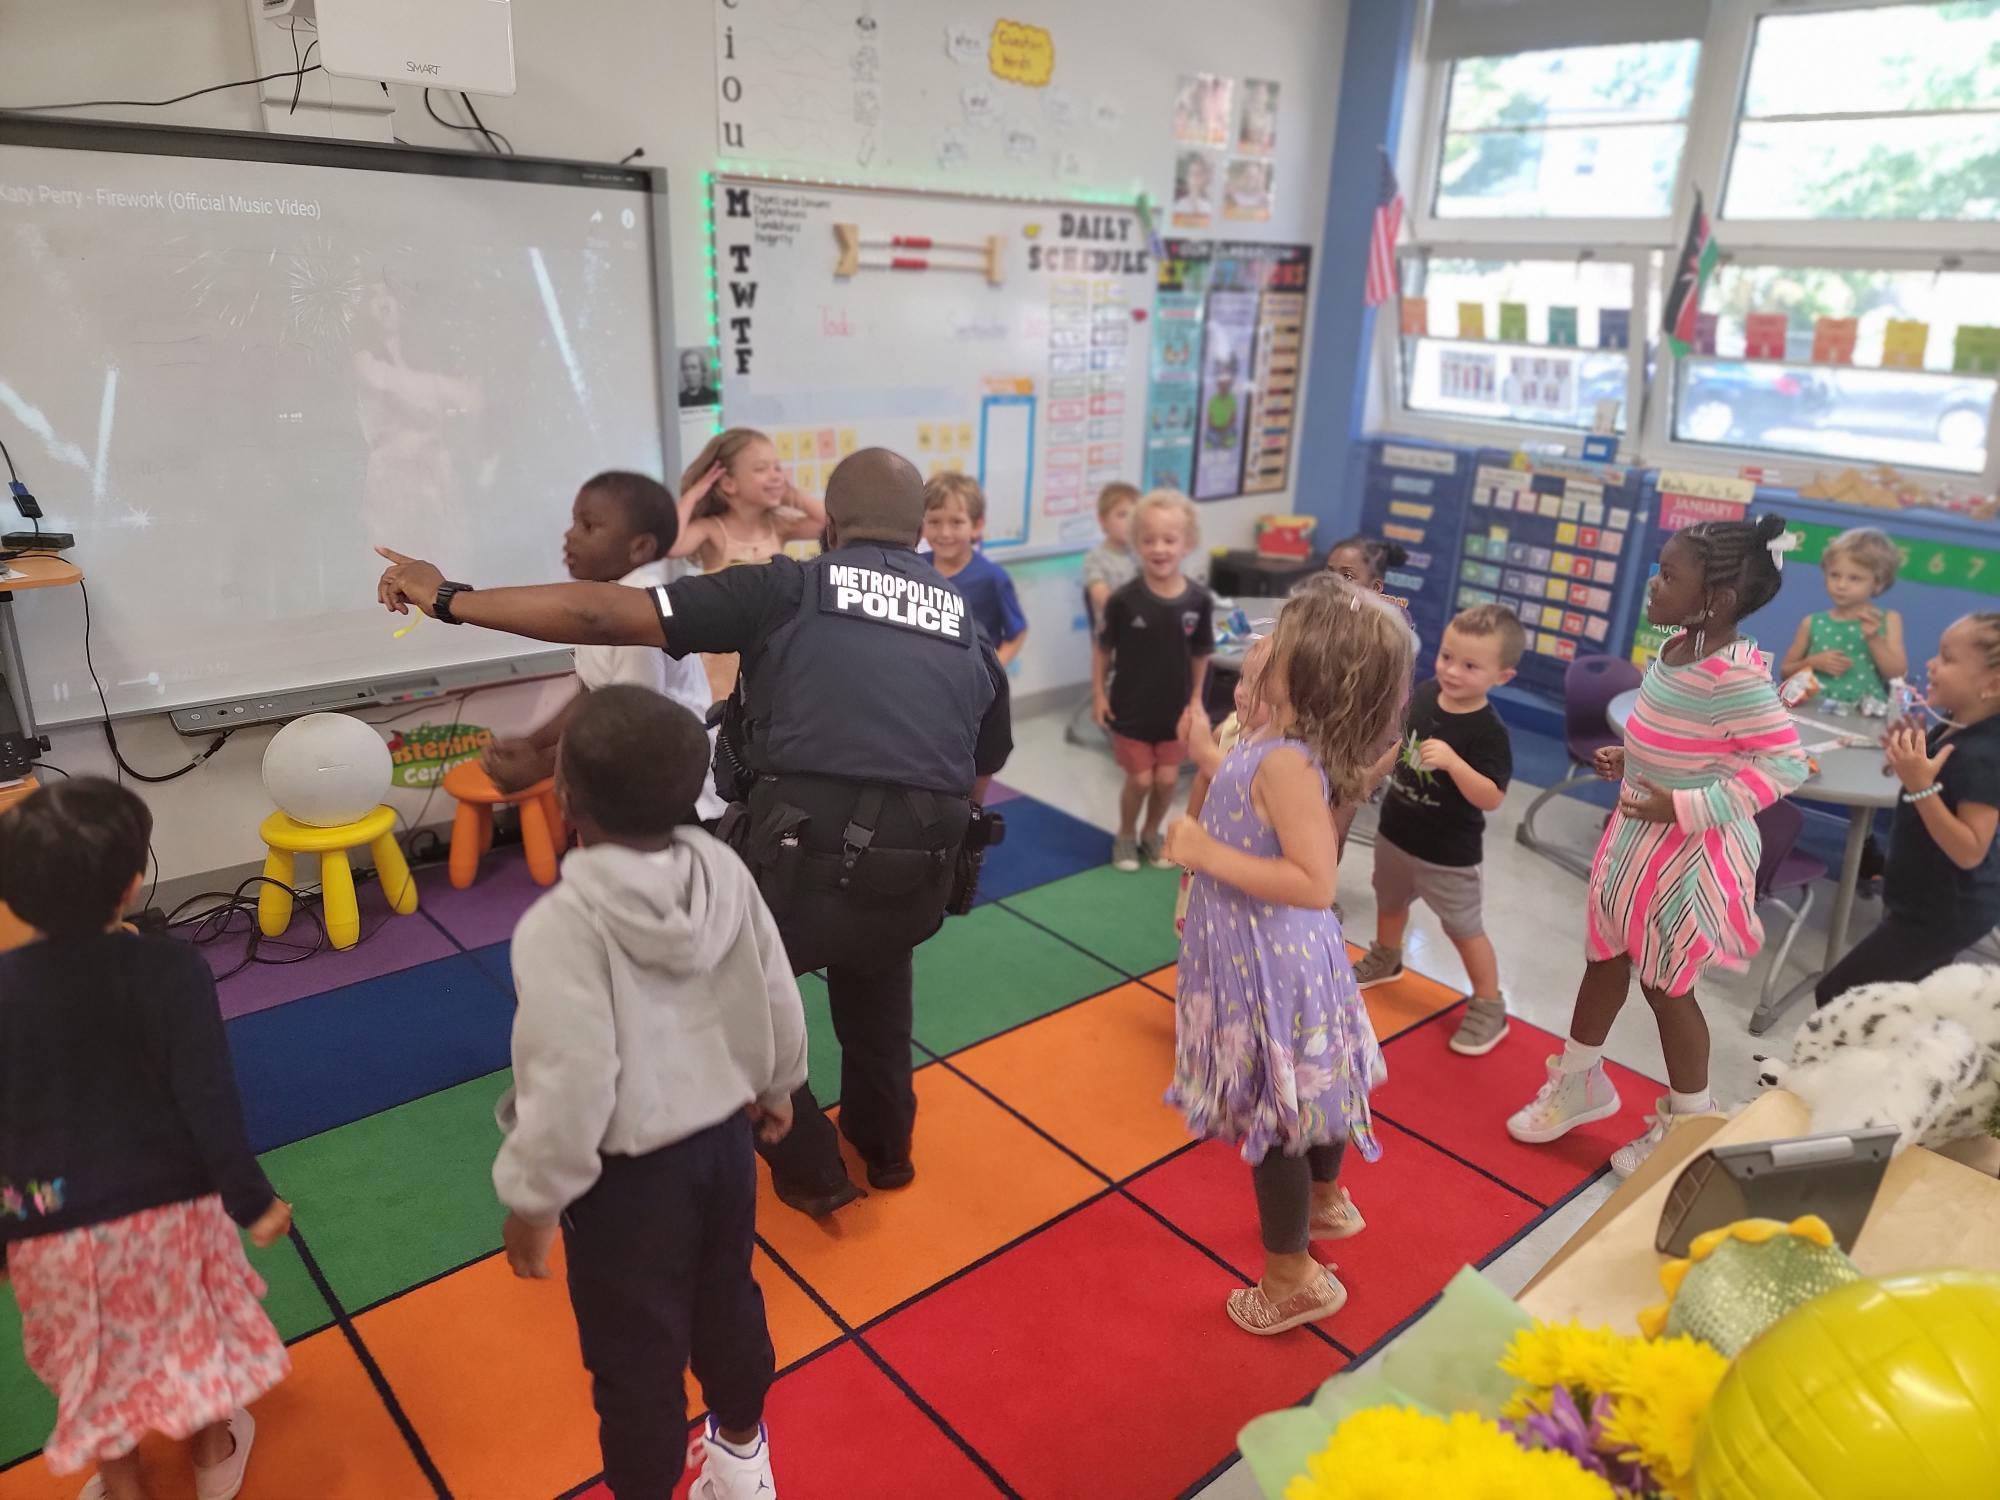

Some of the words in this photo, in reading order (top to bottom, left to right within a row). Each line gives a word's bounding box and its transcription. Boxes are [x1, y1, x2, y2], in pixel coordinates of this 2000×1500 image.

[725, 25, 735, 60] i
[406, 61, 441, 76] SMART
[722, 75, 742, 103] o
[723, 121, 745, 149] u
[39, 185, 82, 209] Perry
[96, 188, 165, 210] Firework
[168, 190, 226, 214] (Official
[229, 195, 273, 215] Music
[275, 198, 322, 220] Video)
[726, 188, 751, 218] M
[1060, 212, 1132, 242] DAILY
[729, 245, 751, 273] T
[1028, 244, 1149, 275] SCHEDULE
[729, 282, 758, 309] W
[731, 317, 752, 345] T
[735, 348, 752, 375] F
[1673, 496, 1734, 517] JANUARY
[1927, 553, 1945, 575] 6
[1967, 557, 1985, 579] 7
[829, 564, 965, 618] METROPOLITAN
[837, 586, 961, 638] POLICE
